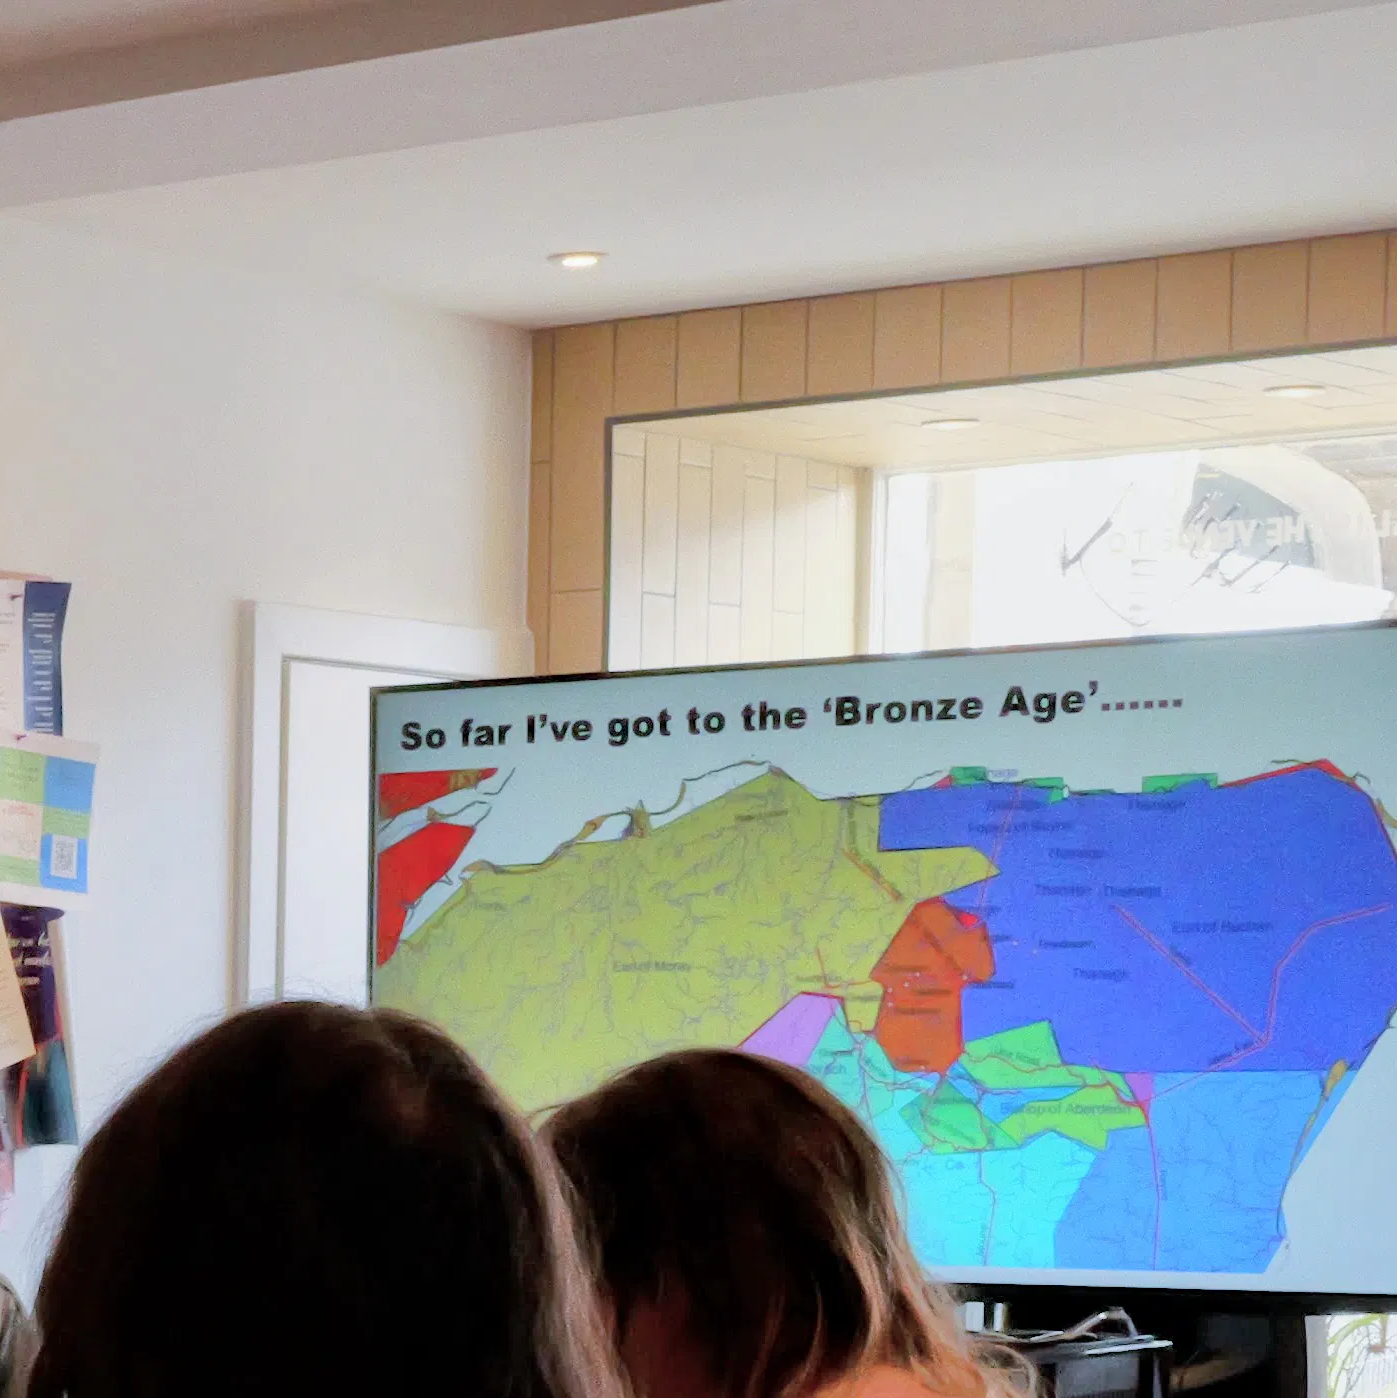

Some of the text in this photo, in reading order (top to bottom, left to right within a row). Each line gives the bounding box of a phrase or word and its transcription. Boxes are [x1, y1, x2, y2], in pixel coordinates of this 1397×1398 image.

[401, 720, 447, 751] So
[460, 717, 512, 747] far
[607, 708, 672, 747] got
[686, 706, 726, 735] to
[741, 701, 807, 732] the
